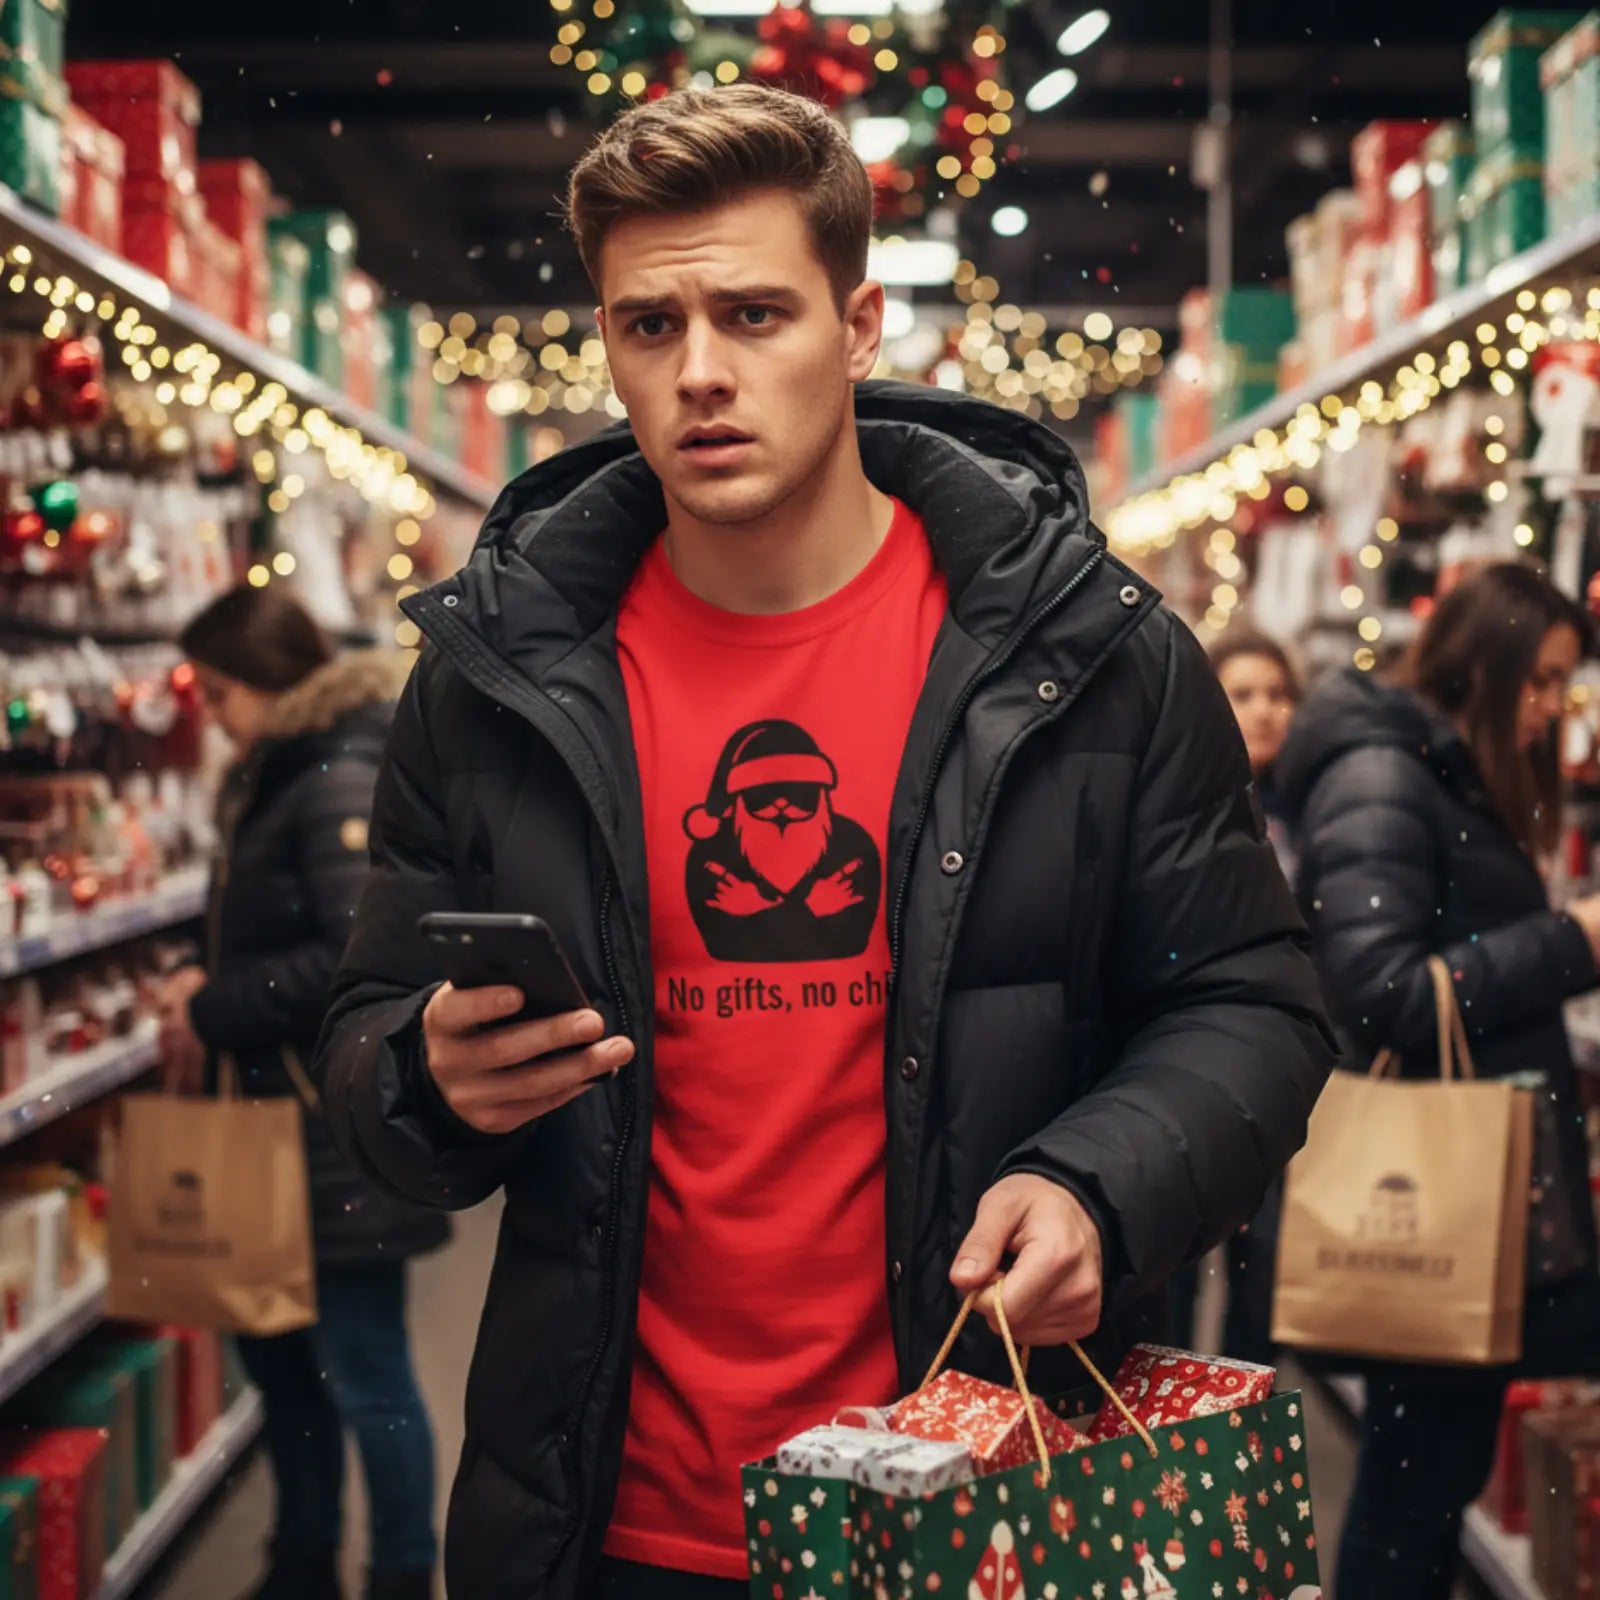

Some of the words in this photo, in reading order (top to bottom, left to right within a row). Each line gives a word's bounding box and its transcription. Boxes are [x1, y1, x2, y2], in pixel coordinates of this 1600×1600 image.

[668, 977, 704, 1012] No
[716, 976, 792, 1018] gifts,
[801, 977, 836, 1007] no
